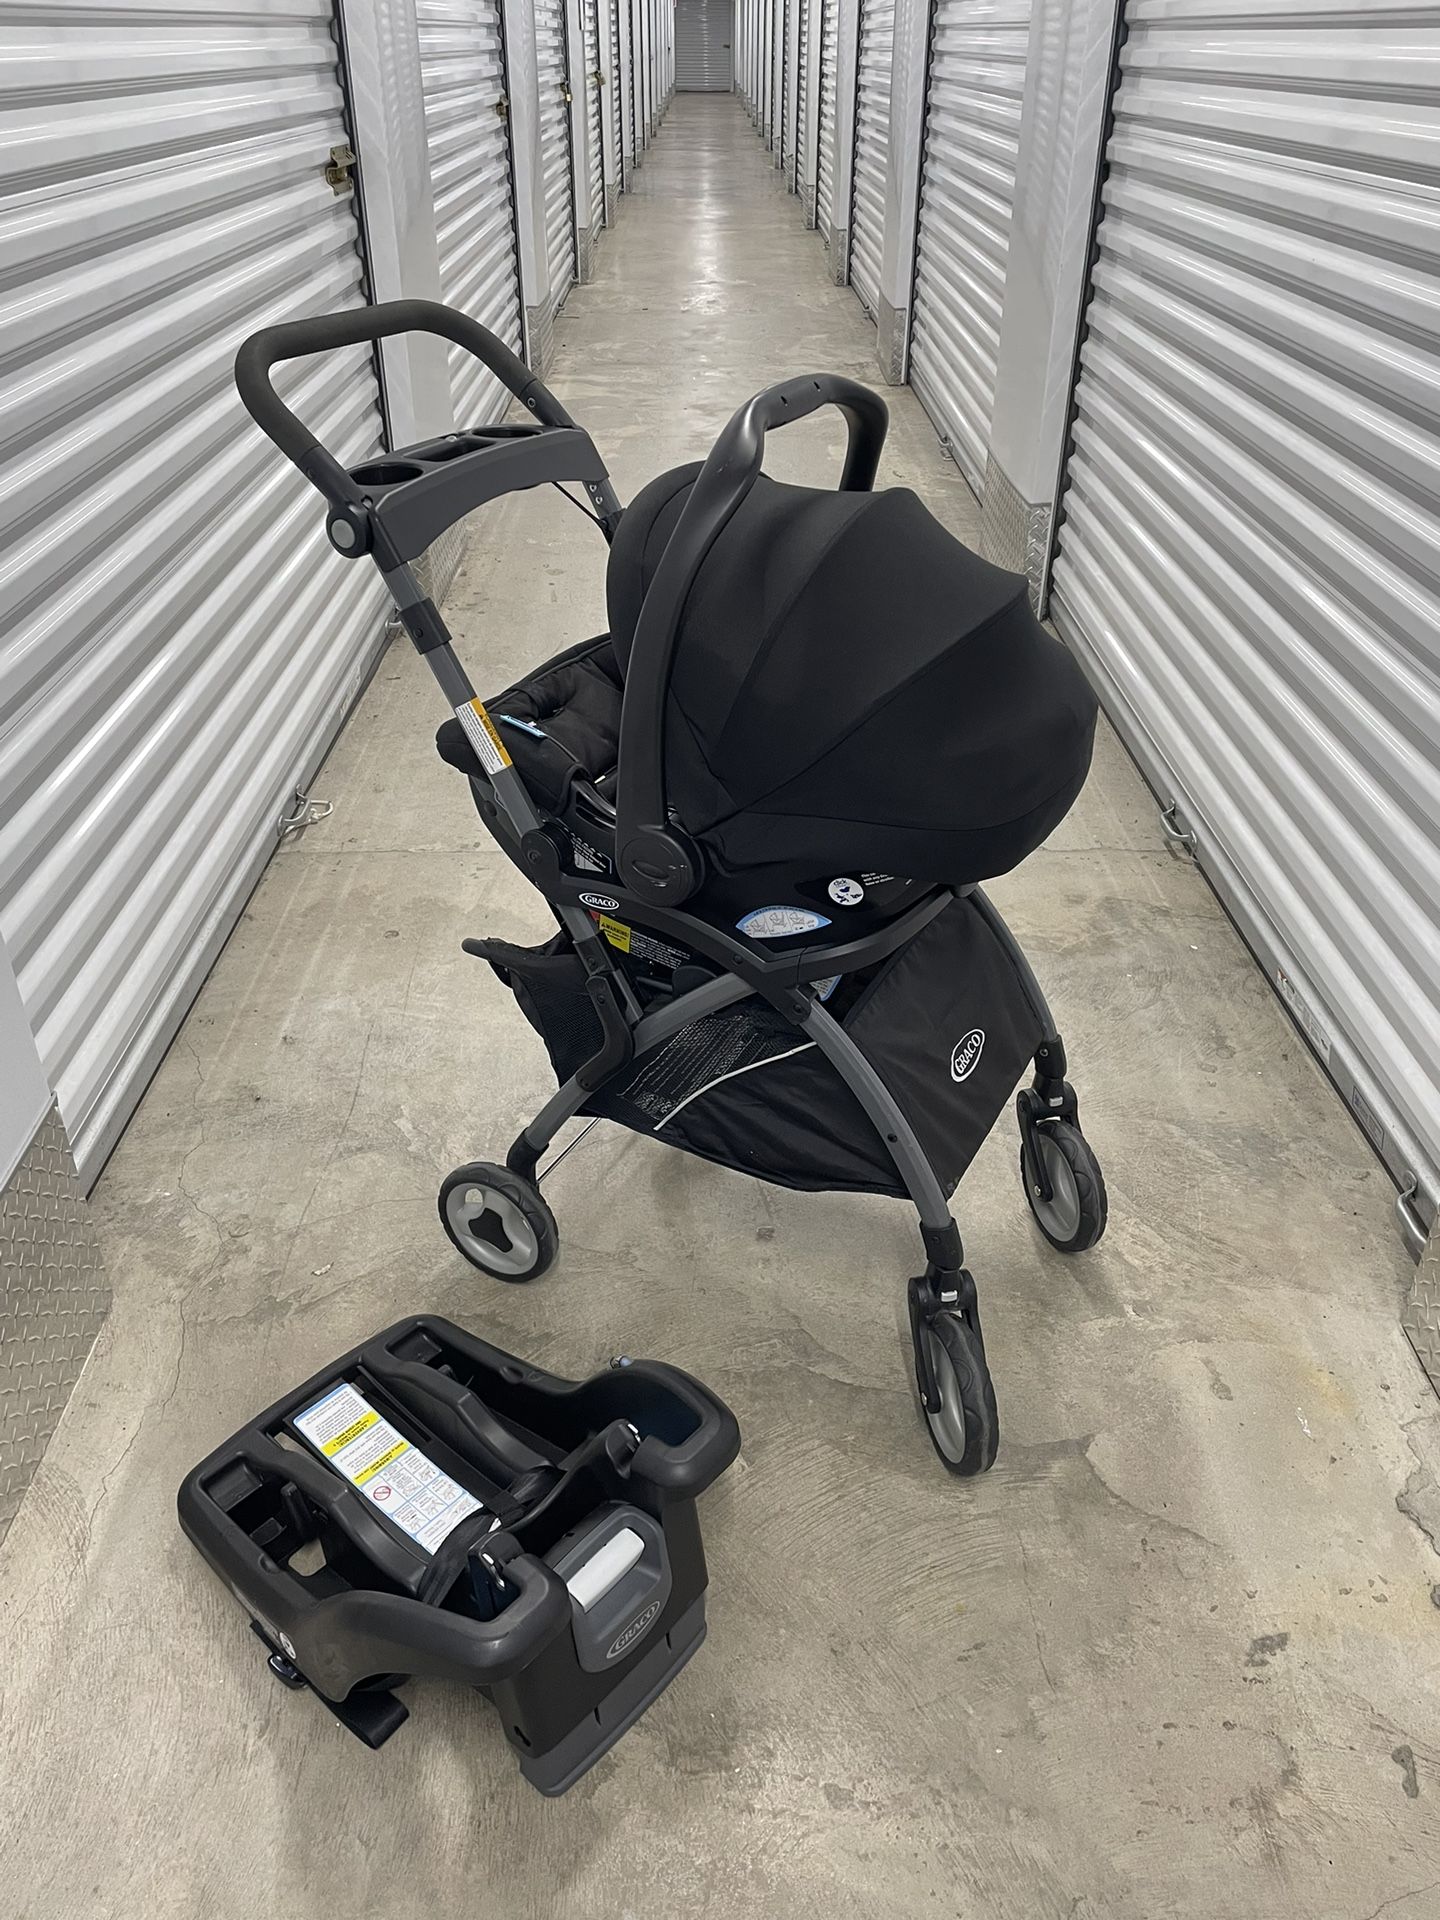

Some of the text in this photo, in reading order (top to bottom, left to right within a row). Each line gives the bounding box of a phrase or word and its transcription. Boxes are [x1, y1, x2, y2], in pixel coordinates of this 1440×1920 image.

[584, 895, 615, 908] GRACO
[954, 1033, 981, 1074] GRACO
[615, 1606, 656, 1650] GRACO
